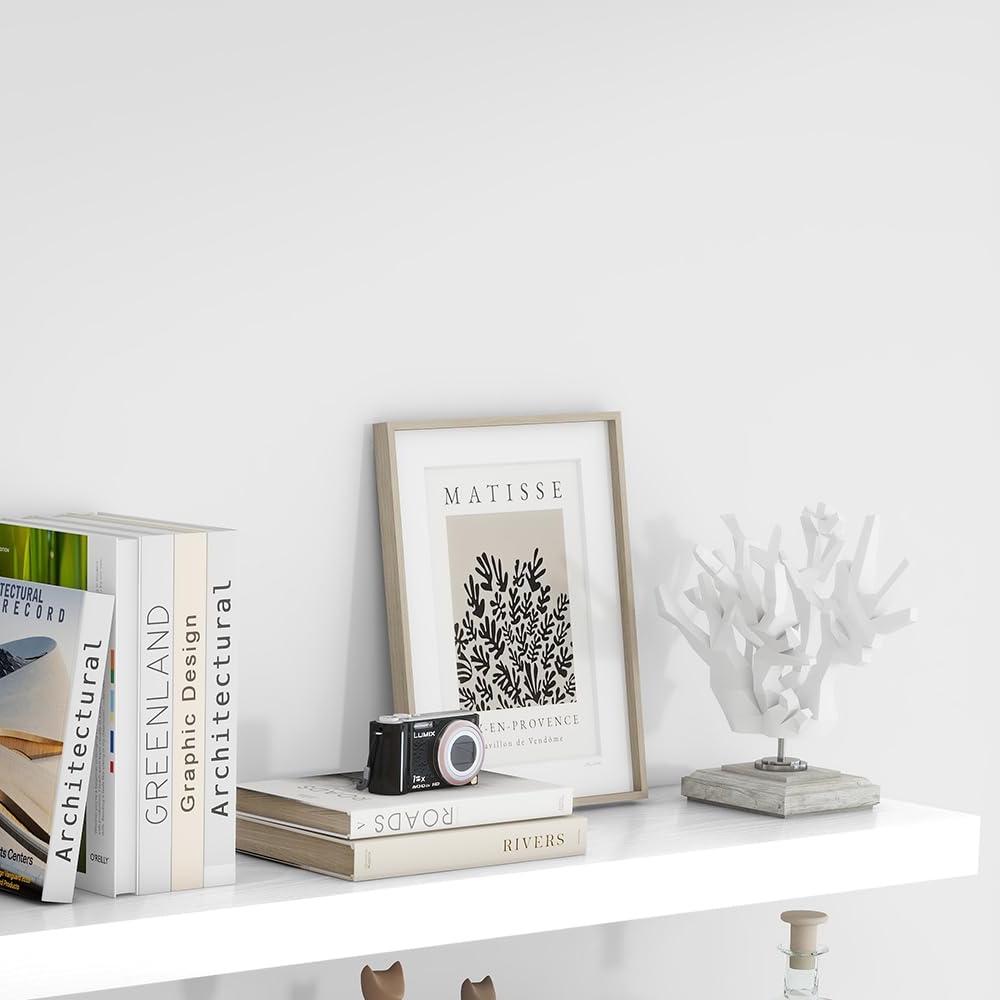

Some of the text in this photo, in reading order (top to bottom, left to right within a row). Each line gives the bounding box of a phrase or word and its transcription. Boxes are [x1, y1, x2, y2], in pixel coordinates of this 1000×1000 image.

[443, 480, 563, 506] MATISSE
[2, 599, 65, 623] RECORD
[211, 579, 232, 817] Architectural
[145, 605, 170, 825] GREENLAND
[180, 614, 201, 812] Graphic Design
[479, 714, 580, 734] -EN-PROVENCE
[413, 730, 436, 739] LUMIX
[485, 740, 513, 750] avillon
[516, 738, 525, 746] de
[55, 640, 102, 863] Architectural
[374, 807, 454, 833] ROADS
[503, 833, 565, 852] RIVERS
[7, 848, 34, 866] Centers
